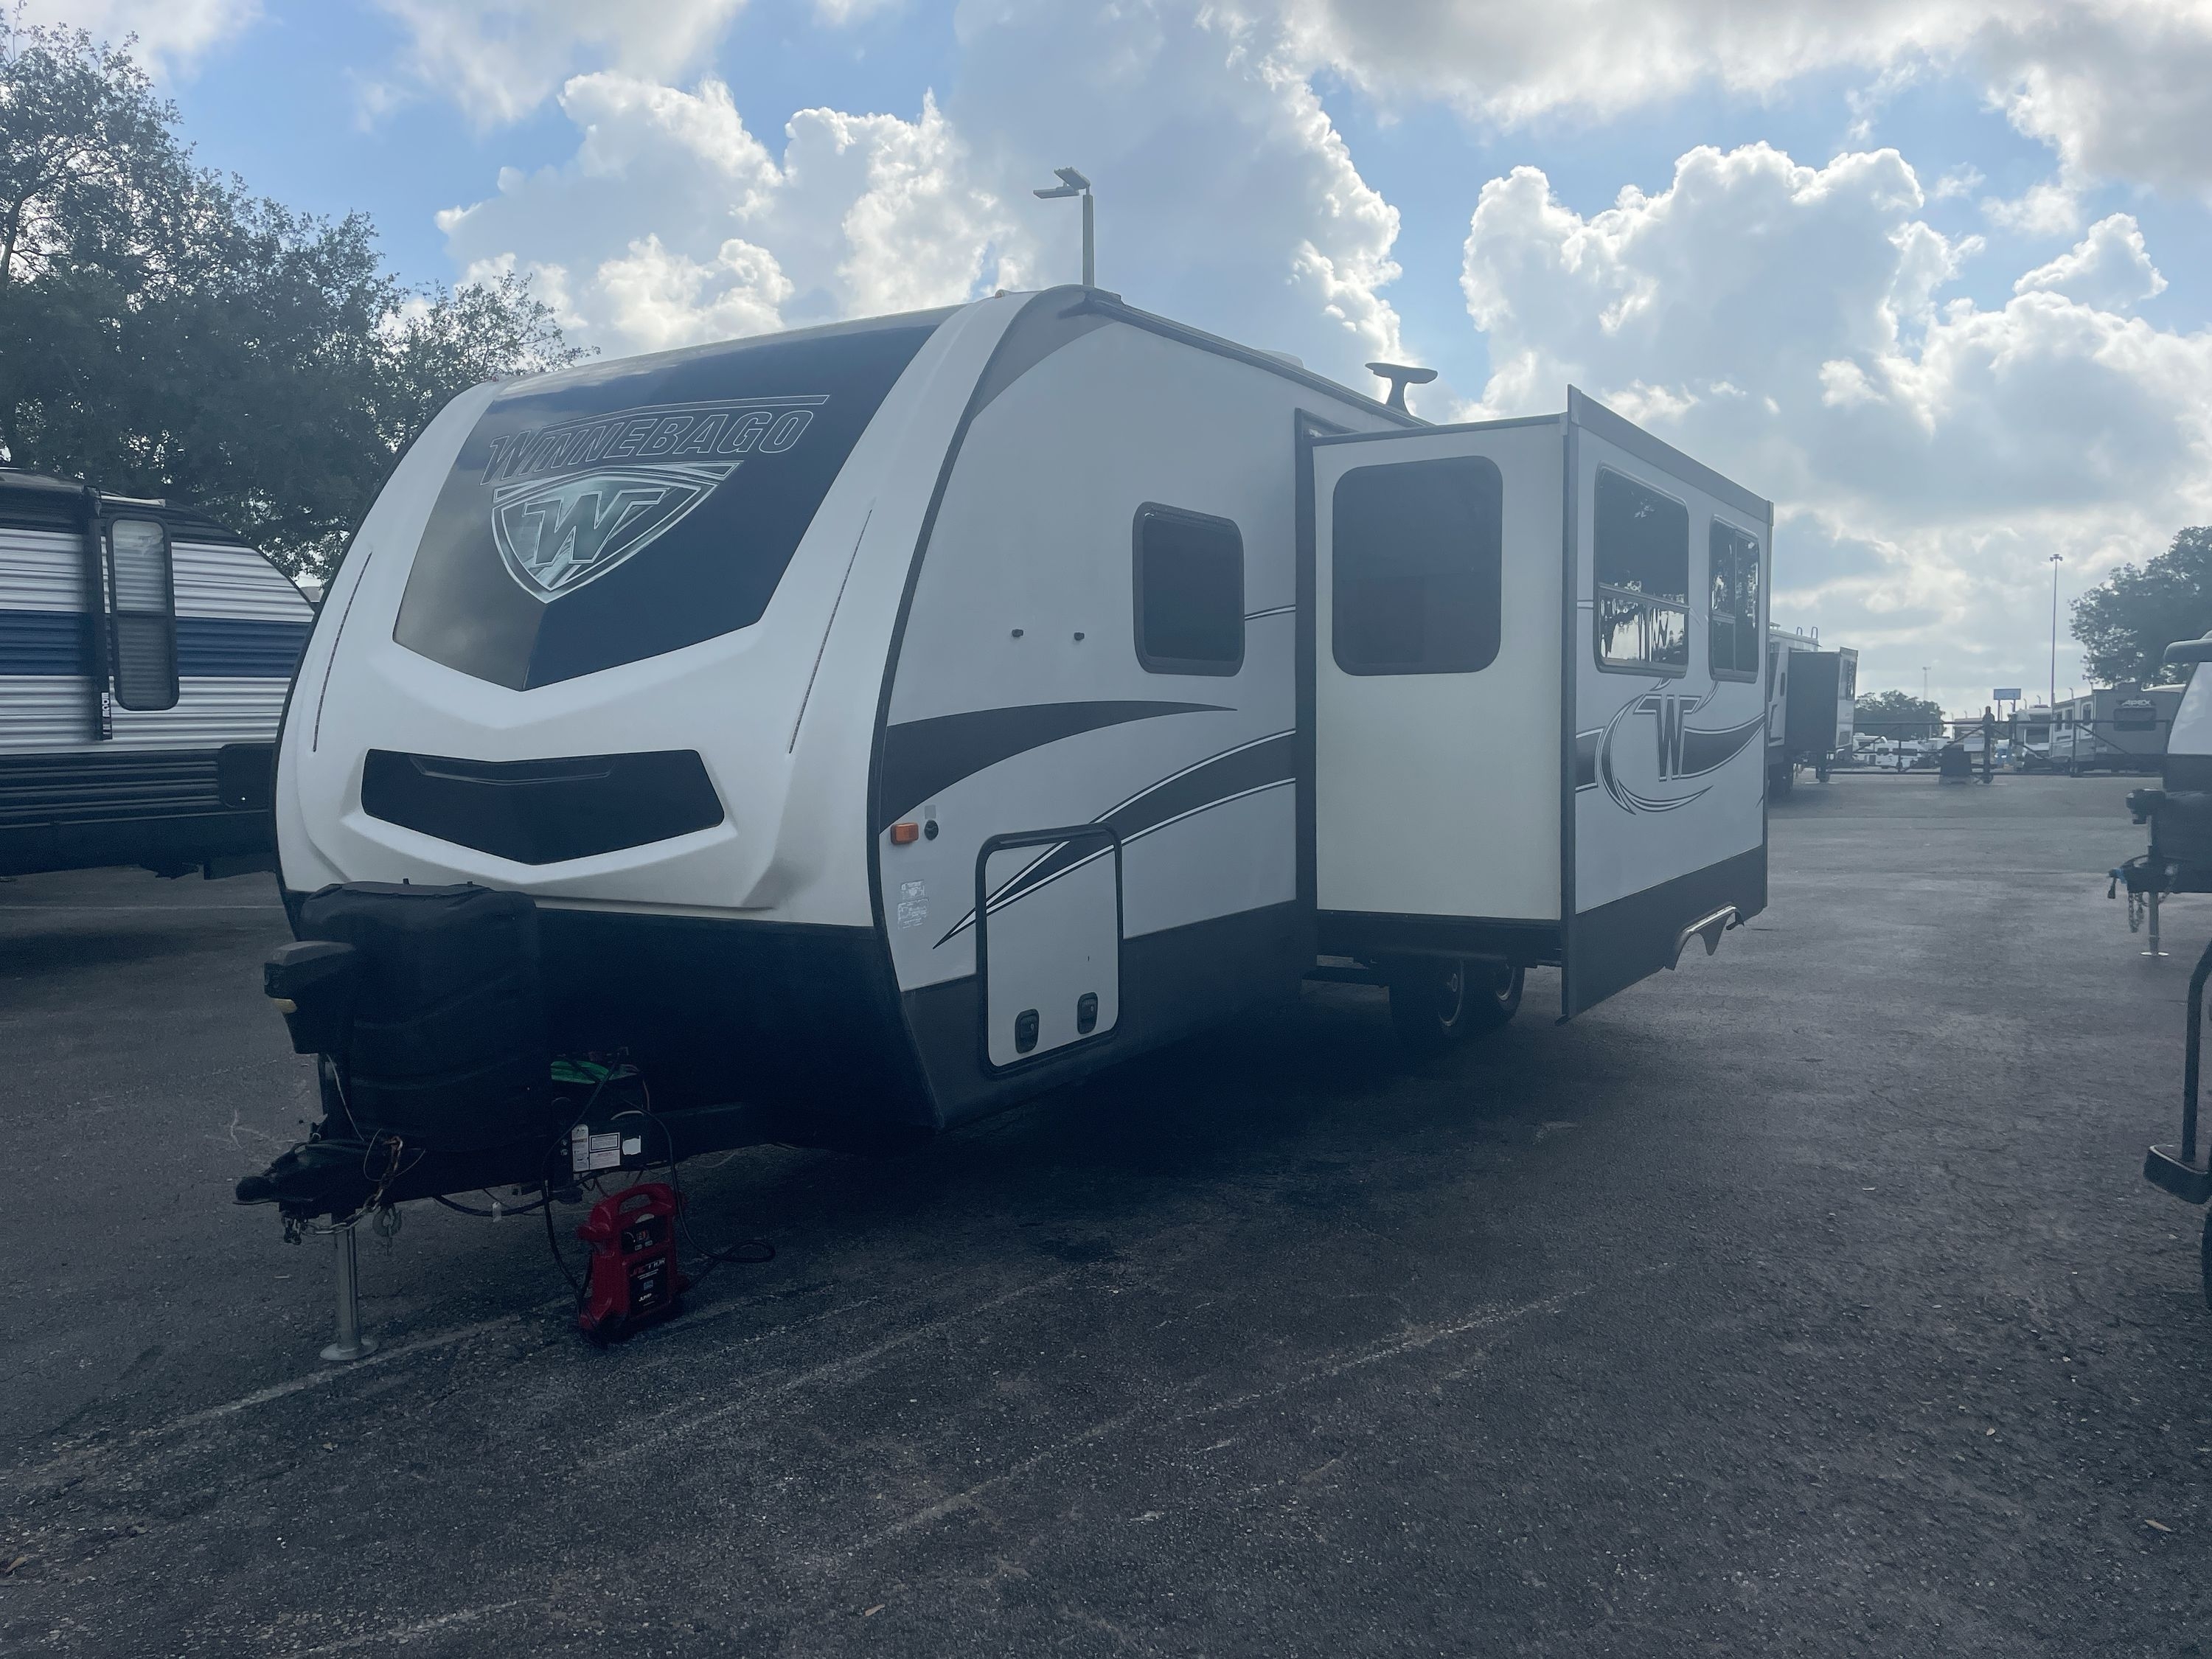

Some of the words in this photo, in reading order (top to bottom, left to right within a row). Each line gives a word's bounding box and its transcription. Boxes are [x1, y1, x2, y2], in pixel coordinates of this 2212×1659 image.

[479, 410, 814, 486] WINNEBAGO
[522, 487, 669, 568] W
[1632, 694, 1703, 782] W
